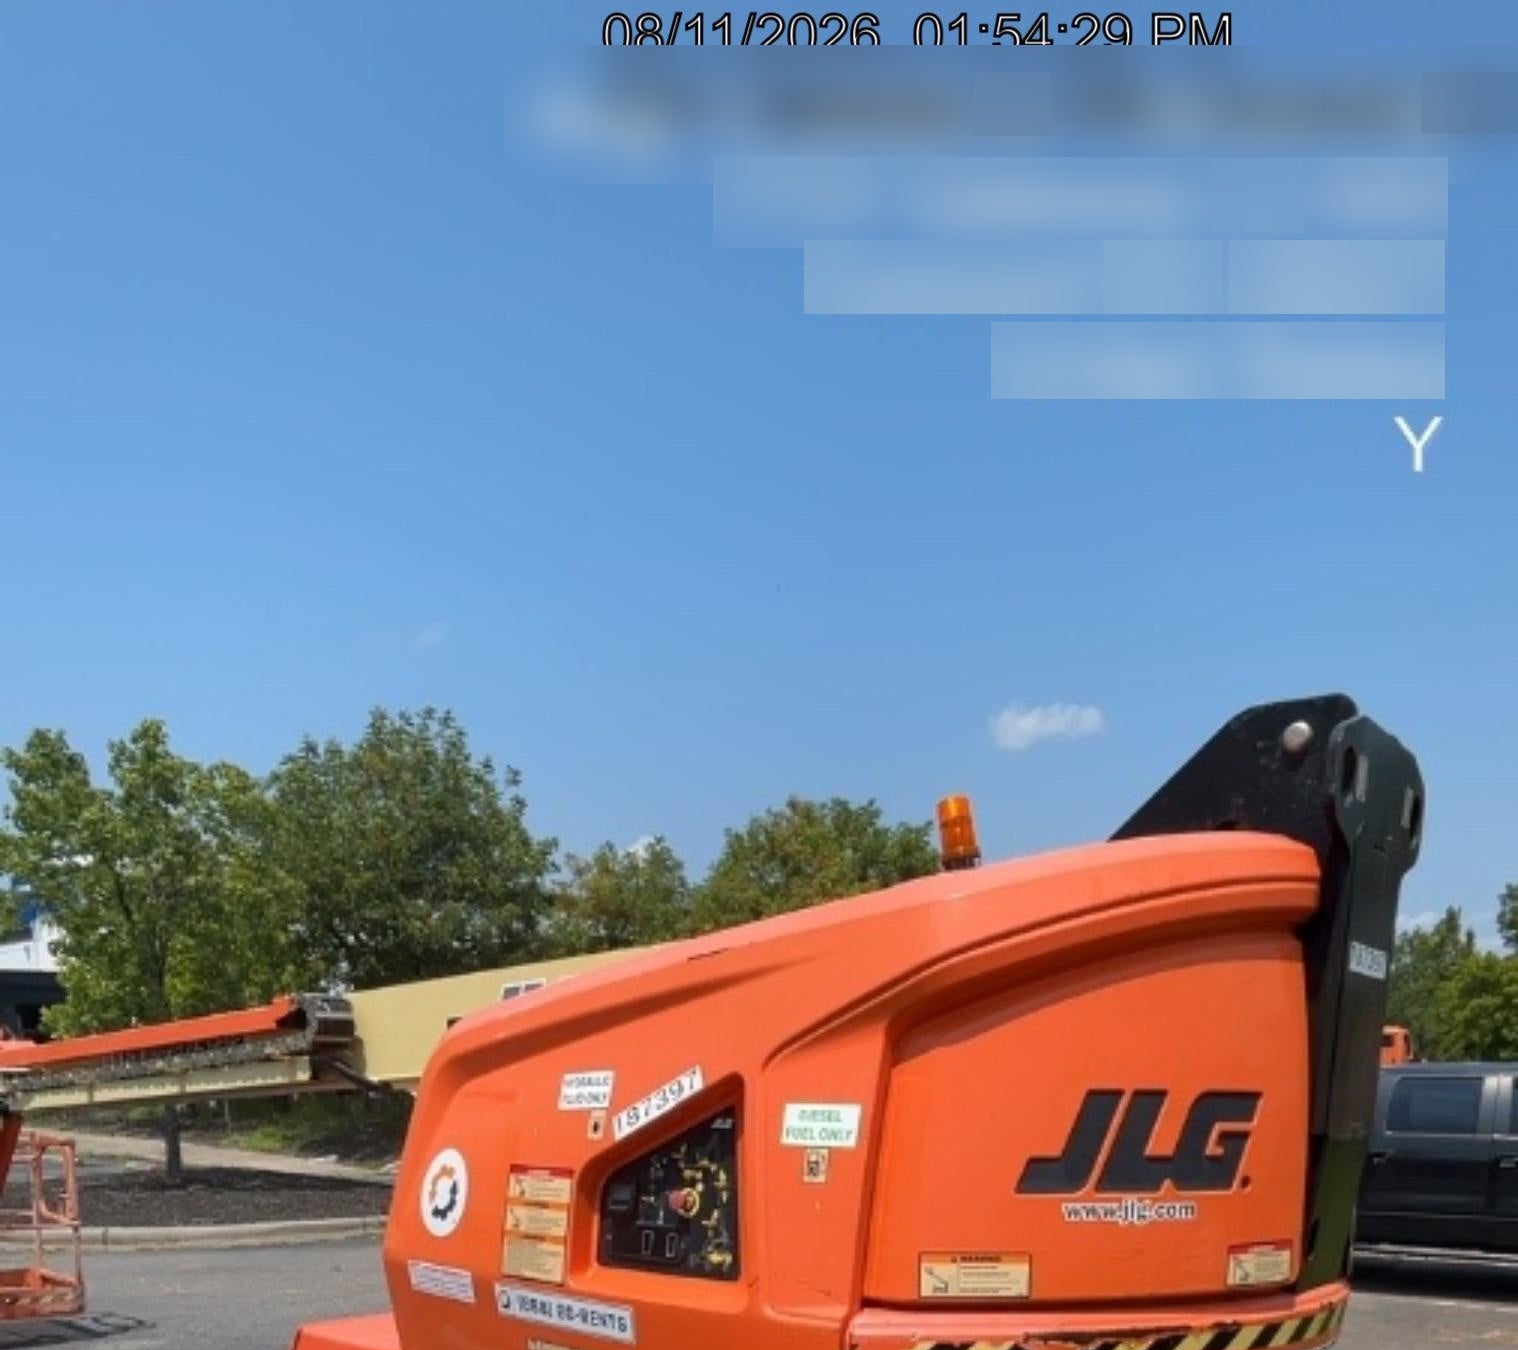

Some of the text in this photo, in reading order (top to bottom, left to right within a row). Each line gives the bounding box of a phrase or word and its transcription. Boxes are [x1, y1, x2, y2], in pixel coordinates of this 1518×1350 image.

[617, 1070, 697, 1132] 187397
[785, 1127, 853, 1141] FUEL ONLY
[1015, 1089, 1262, 1194] JLG
[1064, 1199, 1195, 1224] www.jlg.com
